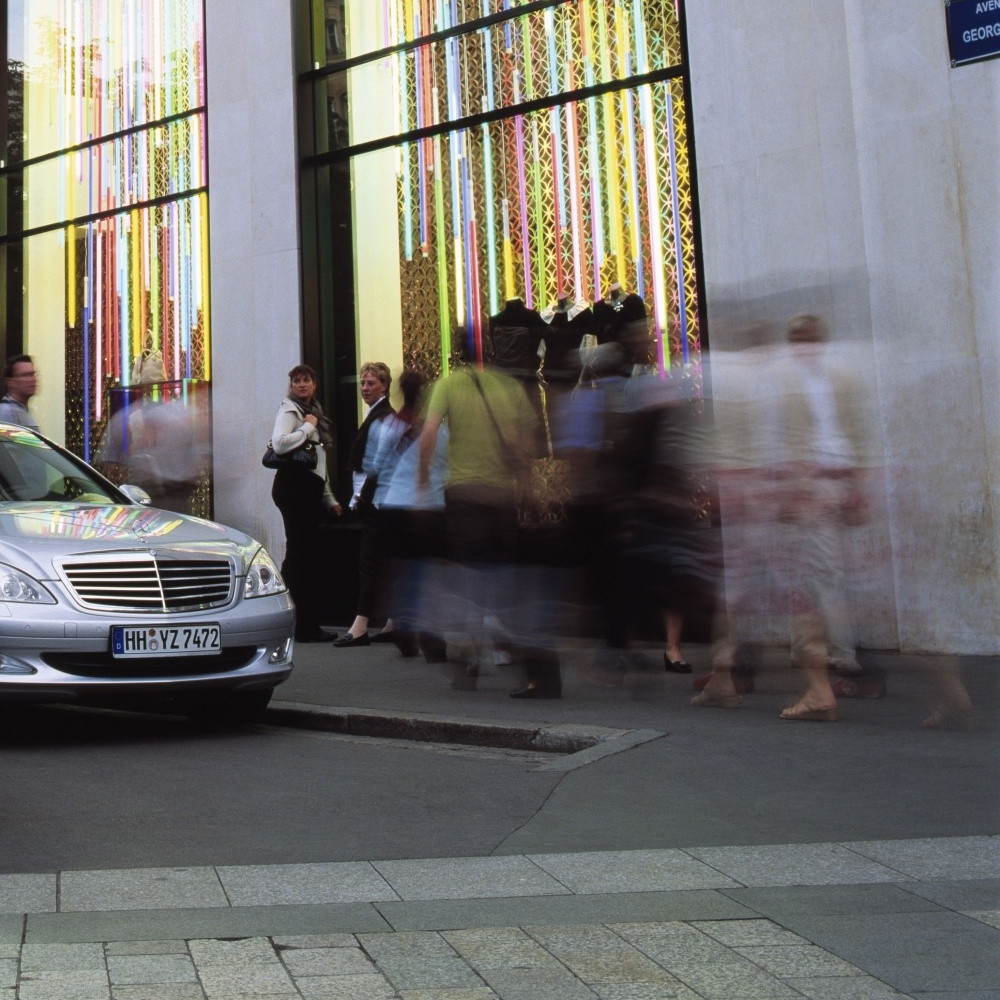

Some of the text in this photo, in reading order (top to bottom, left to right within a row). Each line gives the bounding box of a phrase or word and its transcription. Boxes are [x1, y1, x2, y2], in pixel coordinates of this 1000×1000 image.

[125, 630, 147, 650] HH
[160, 629, 180, 650] YZ
[183, 628, 220, 649] 7472
